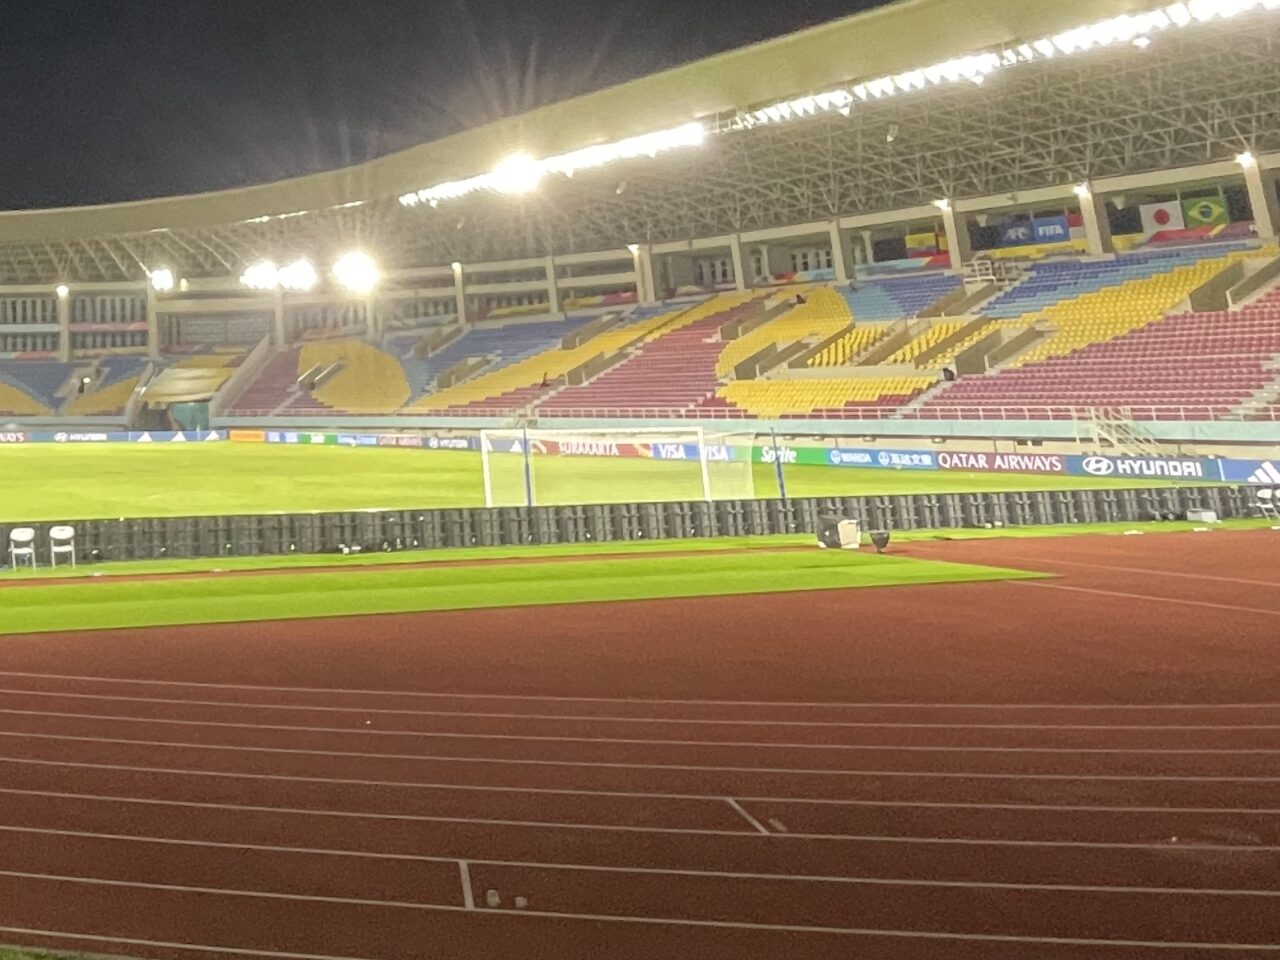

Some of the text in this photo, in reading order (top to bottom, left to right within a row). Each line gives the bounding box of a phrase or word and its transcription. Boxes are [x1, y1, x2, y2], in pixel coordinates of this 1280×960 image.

[1038, 224, 1064, 237] FIFA
[658, 443, 686, 459] VISA
[937, 452, 1062, 471] QATAR AIRWAYS
[1116, 459, 1203, 477] HYUNDAI
